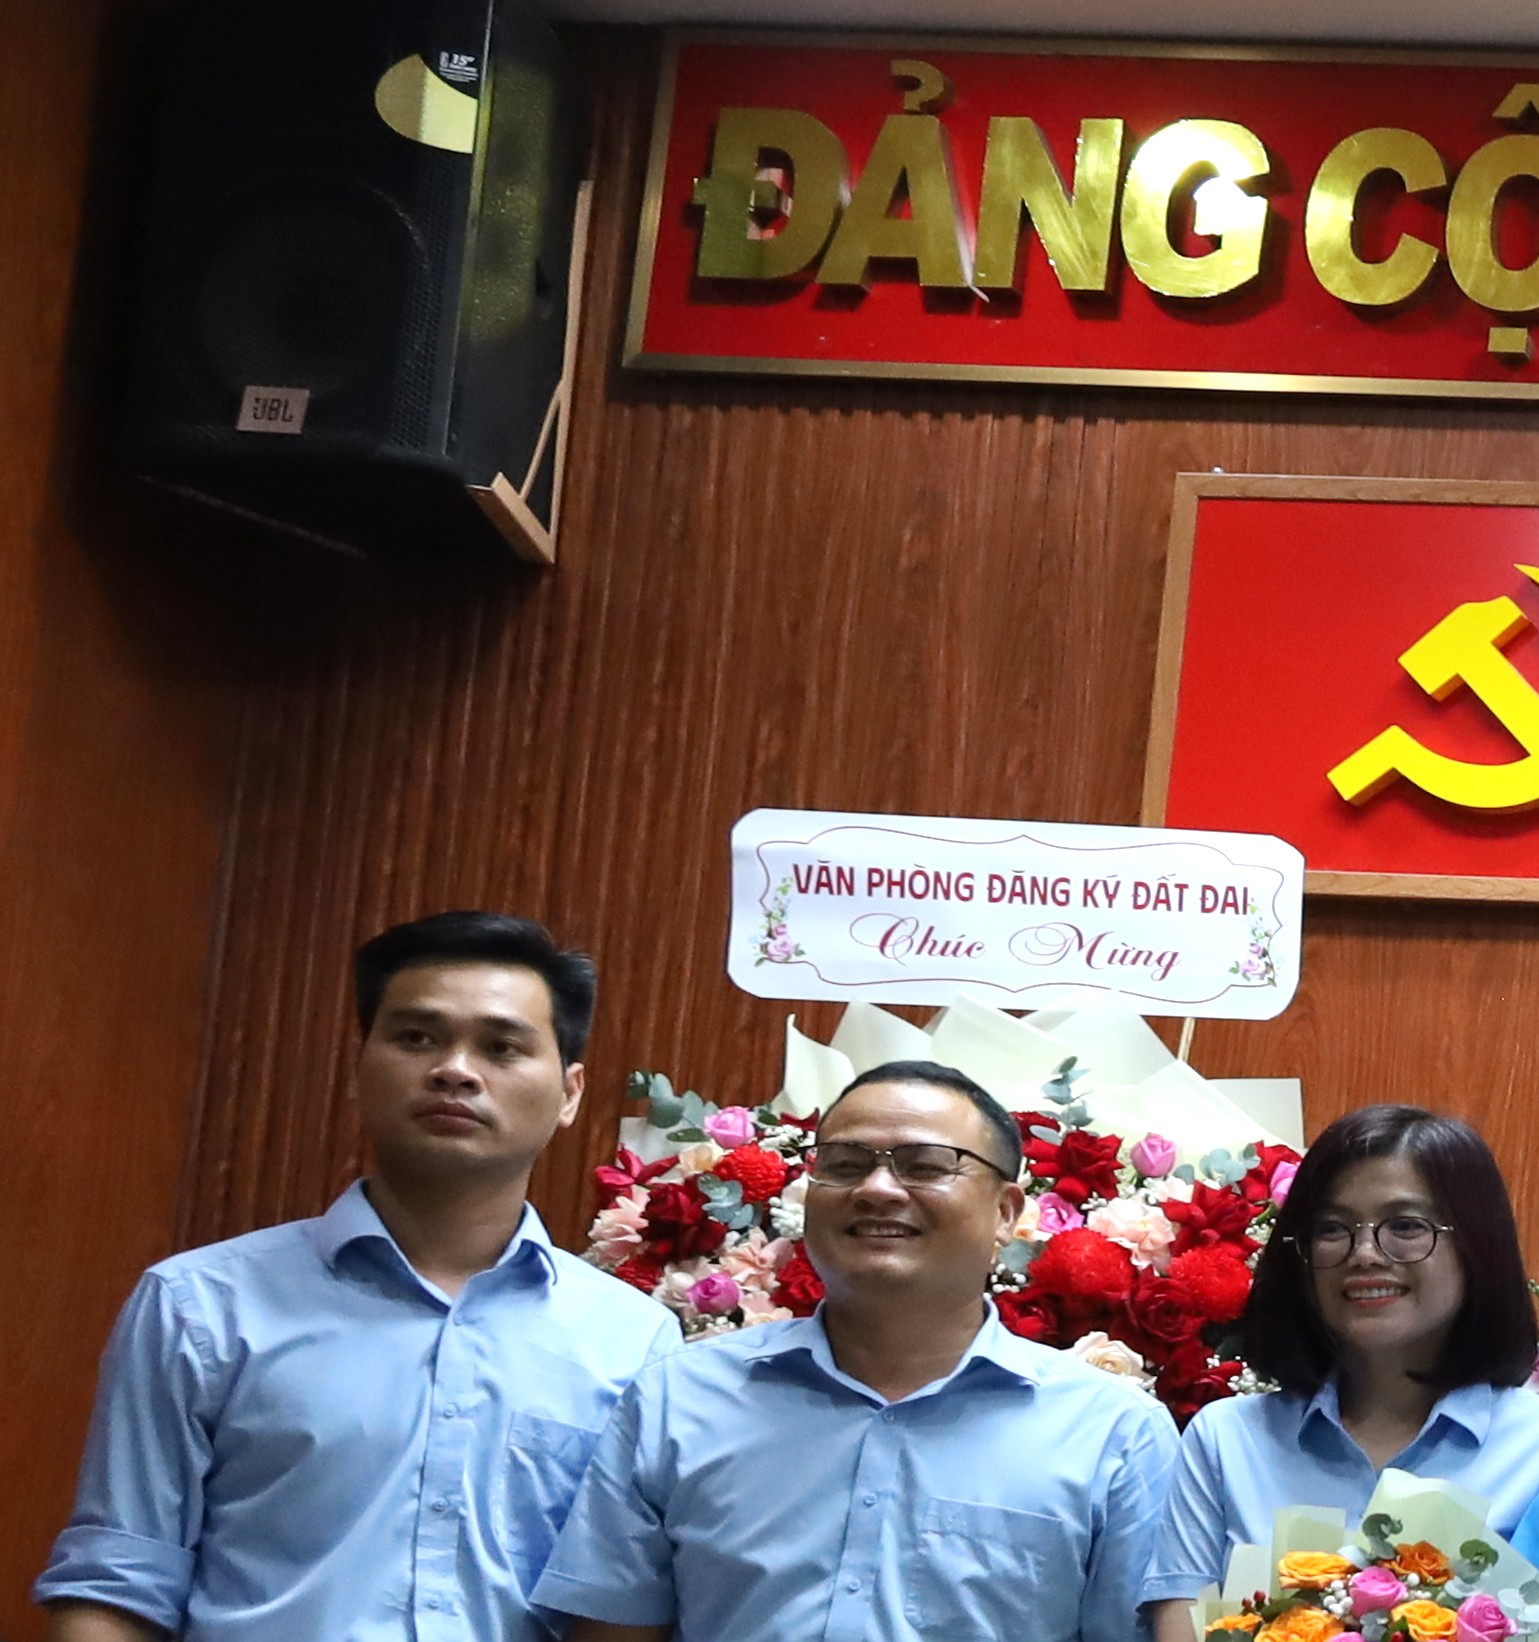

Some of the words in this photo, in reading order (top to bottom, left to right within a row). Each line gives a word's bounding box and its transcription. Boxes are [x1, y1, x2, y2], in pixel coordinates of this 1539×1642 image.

[693, 60, 1272, 304] ĐẢNG
[253, 397, 294, 422] JBL
[793, 859, 853, 897] VĂN
[866, 863, 975, 902] PHÒNG
[986, 870, 1071, 907] ĐĂNG
[1081, 873, 1122, 909] KÝ
[1131, 872, 1189, 912] ĐẤT
[1199, 884, 1251, 916] ĐAI
[848, 911, 986, 966] Chúc
[1008, 920, 1180, 982] Mừng
